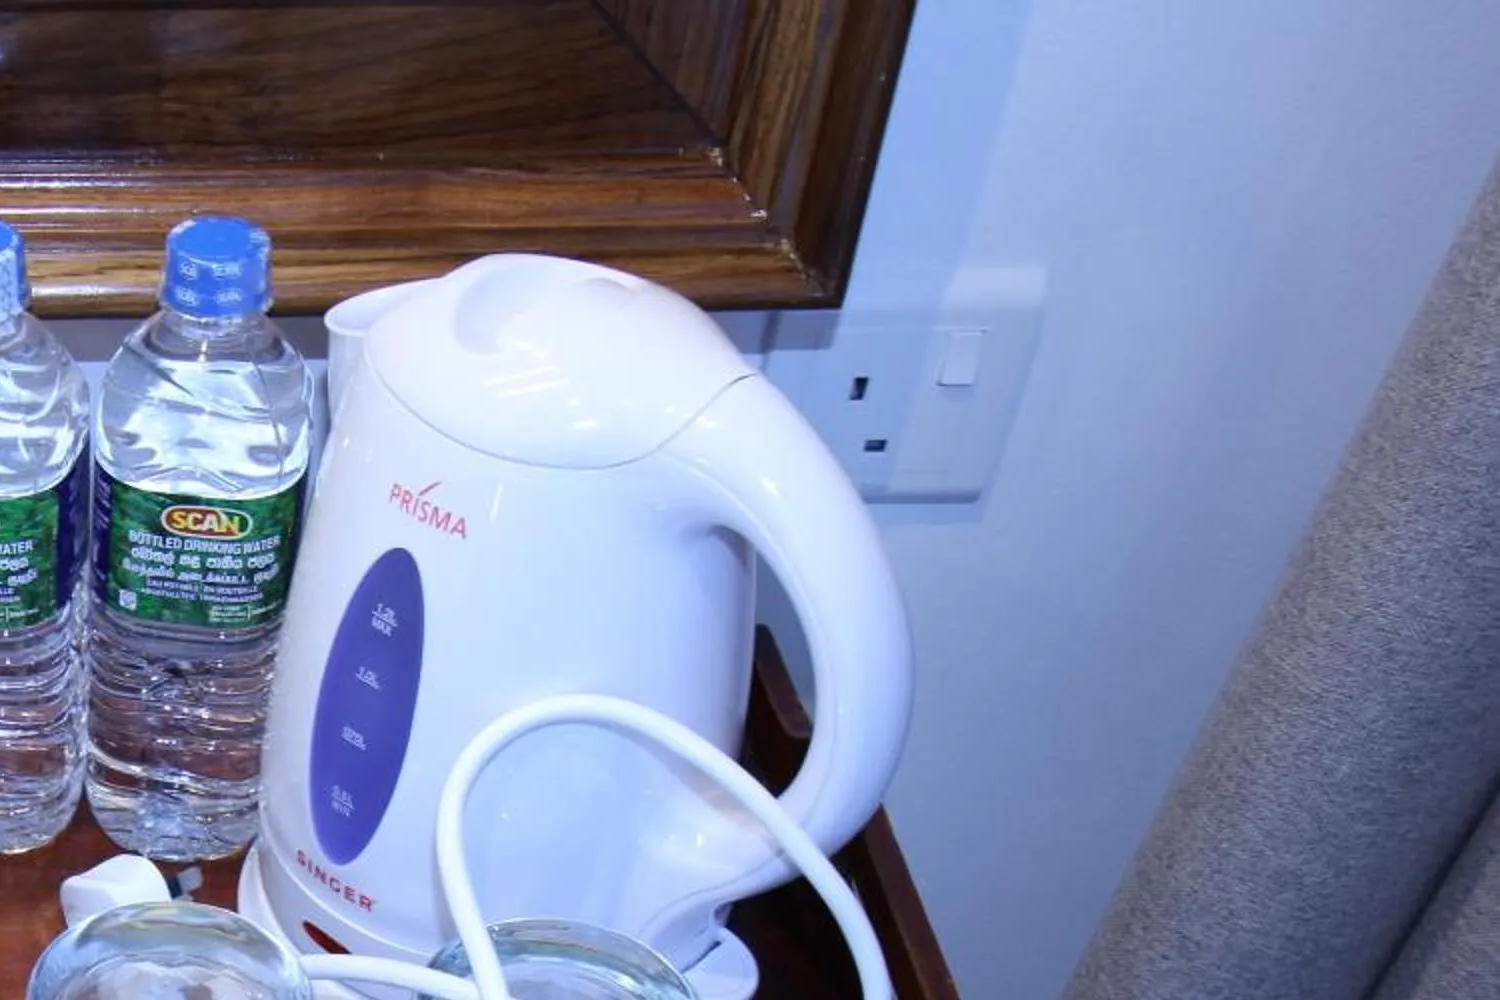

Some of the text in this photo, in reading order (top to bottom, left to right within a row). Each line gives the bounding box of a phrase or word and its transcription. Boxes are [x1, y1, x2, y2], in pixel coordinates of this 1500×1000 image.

[171, 510, 240, 536] SCAN
[389, 482, 467, 539] PRISMA
[128, 529, 281, 555] BOTTLED DRINKING WATER
[297, 848, 373, 911] SINGER
